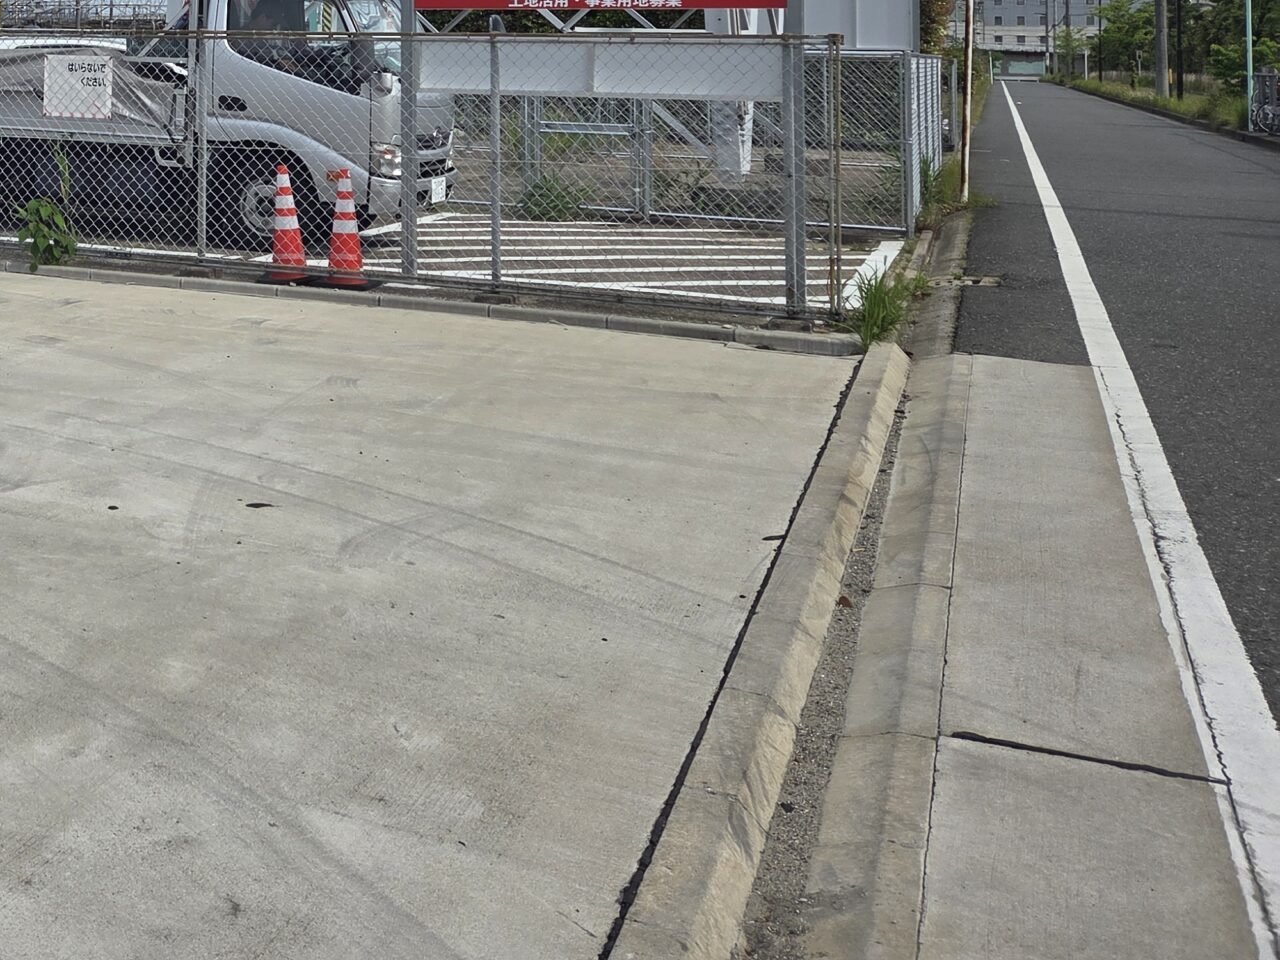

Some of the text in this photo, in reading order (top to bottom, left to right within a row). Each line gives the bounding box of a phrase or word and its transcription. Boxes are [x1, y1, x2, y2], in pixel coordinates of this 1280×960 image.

[67, 62, 107, 73] はいらないで
